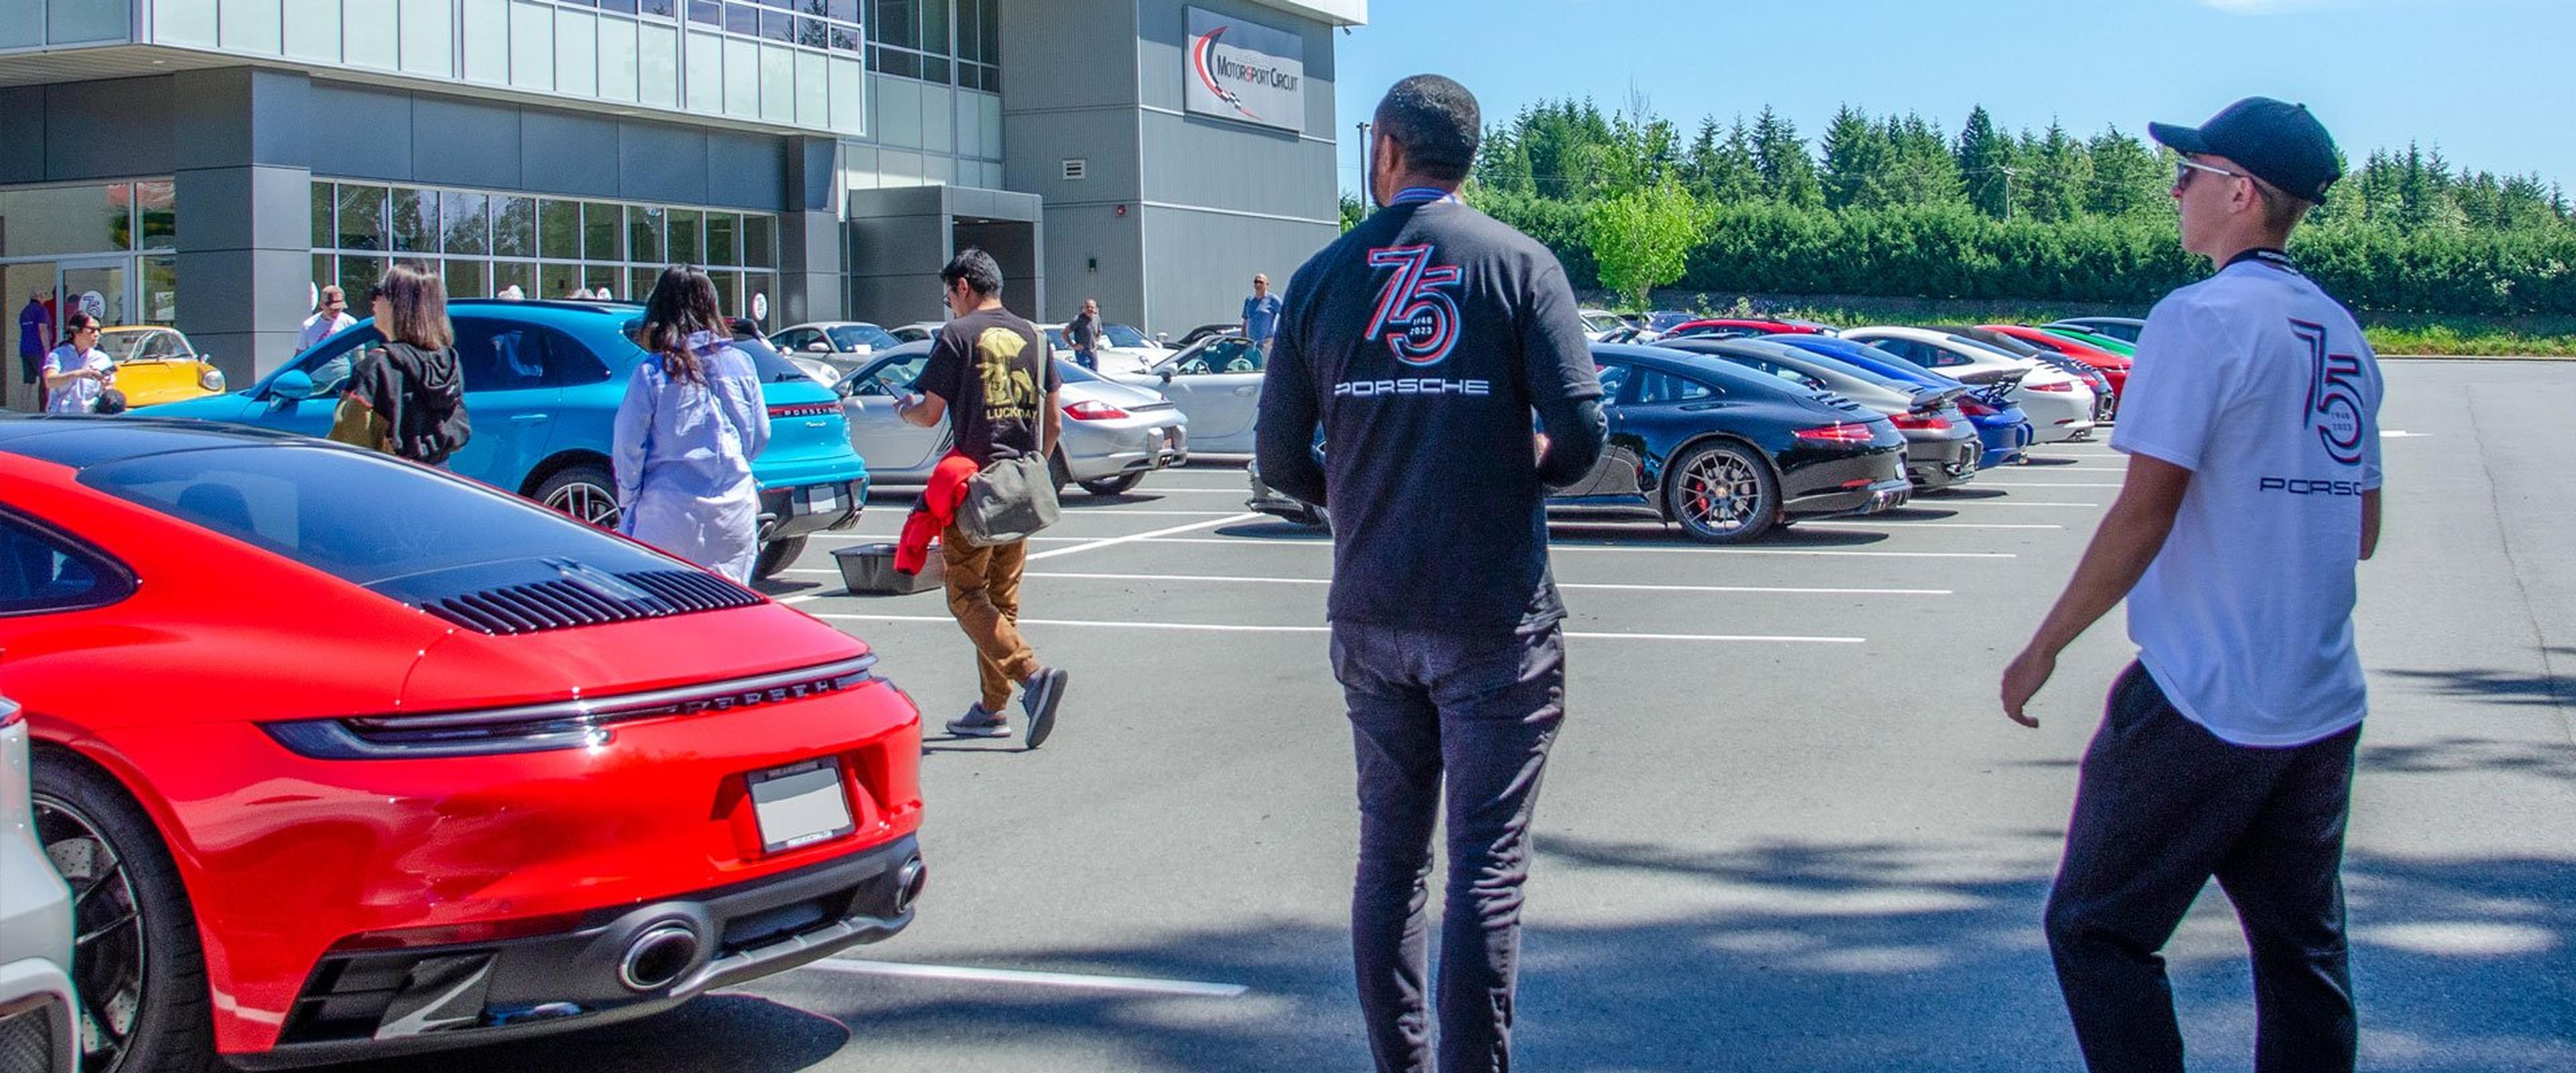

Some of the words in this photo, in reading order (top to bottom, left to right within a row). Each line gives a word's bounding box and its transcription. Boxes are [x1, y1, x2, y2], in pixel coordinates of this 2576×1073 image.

[1270, 67, 1299, 92] CIRCUIT
[1364, 243, 1463, 366] 75
[1409, 326, 1433, 335] 2023
[1334, 378, 1490, 396] PORSCHE
